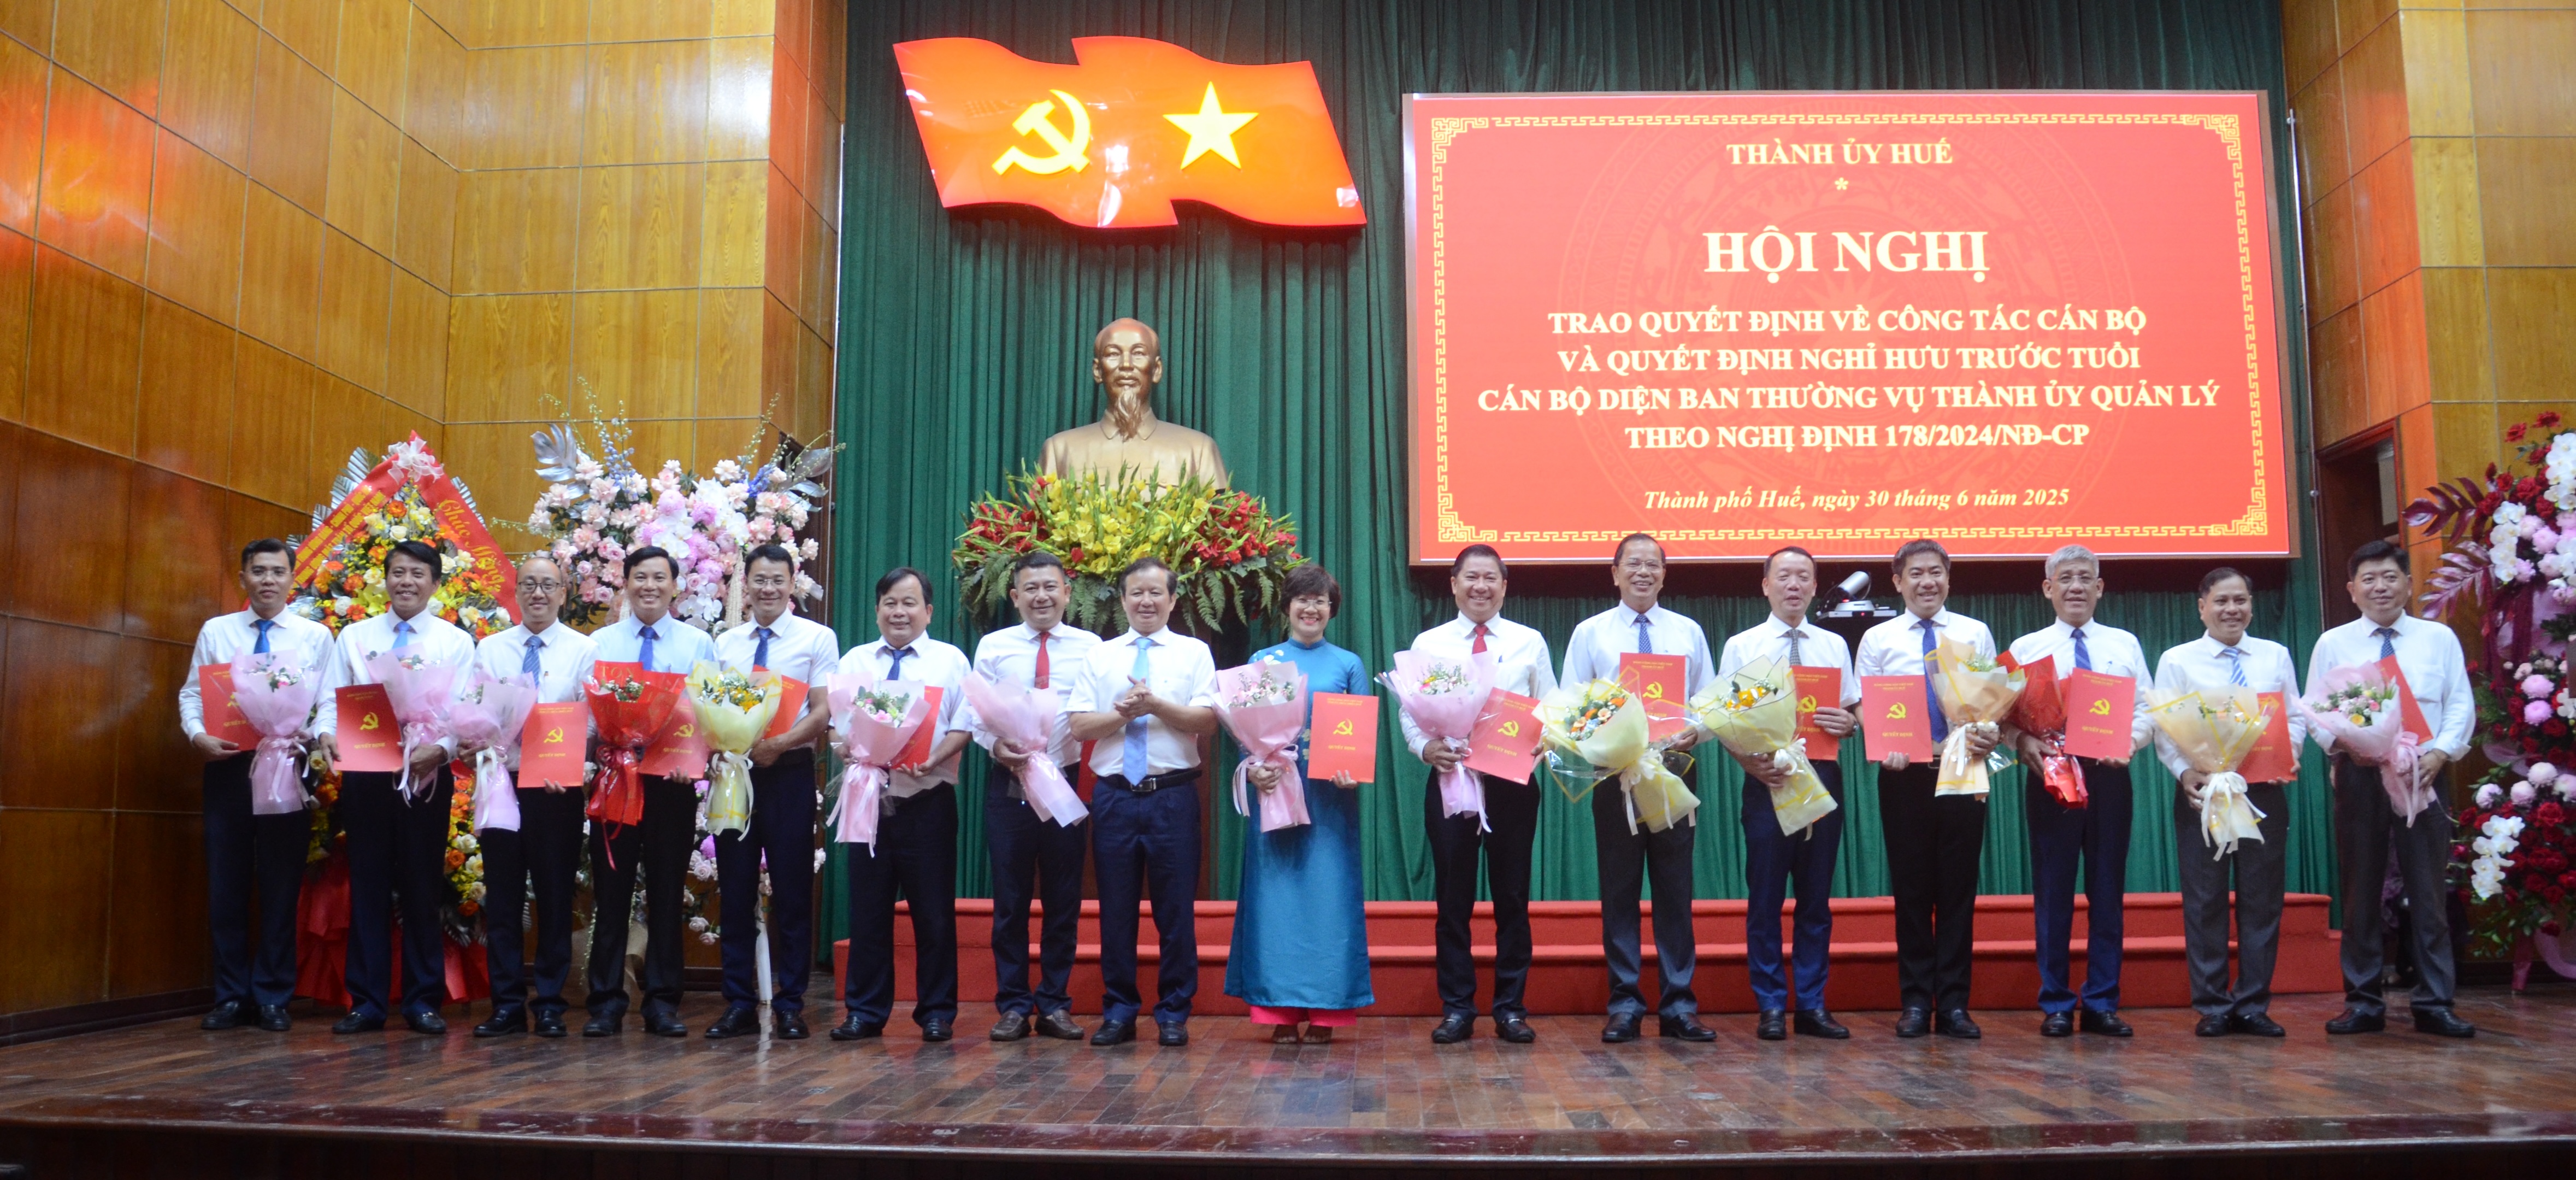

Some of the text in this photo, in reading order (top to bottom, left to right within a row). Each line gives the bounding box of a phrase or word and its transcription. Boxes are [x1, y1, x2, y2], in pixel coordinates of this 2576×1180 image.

[1725, 137, 1953, 165] THÀNH ỦY HUẾ
[1702, 225, 1991, 284] HỘI NGHỊ
[1547, 303, 2147, 338] TRAO QUYẾT ĐỊNH VỀ CÔNG TÁC CÁN BỘ
[1557, 341, 2141, 377] VÀ QUYẾT ĐỊNH NGHỈ HƯU TRƯỚC TUỔI
[1477, 379, 2220, 416] CÁN BỘ DIỆN BAN THƯỜNG VỤ THÀNH ỦY QUẢN LÝ
[1624, 424, 2090, 453] THEO NGHỊ ĐỊNH 178/2024/NĐ-CP
[1644, 485, 2070, 513] Thành phố Huế, ngày 30 tháng 6 năm 2025
[438, 498, 471, 538] Chúc
